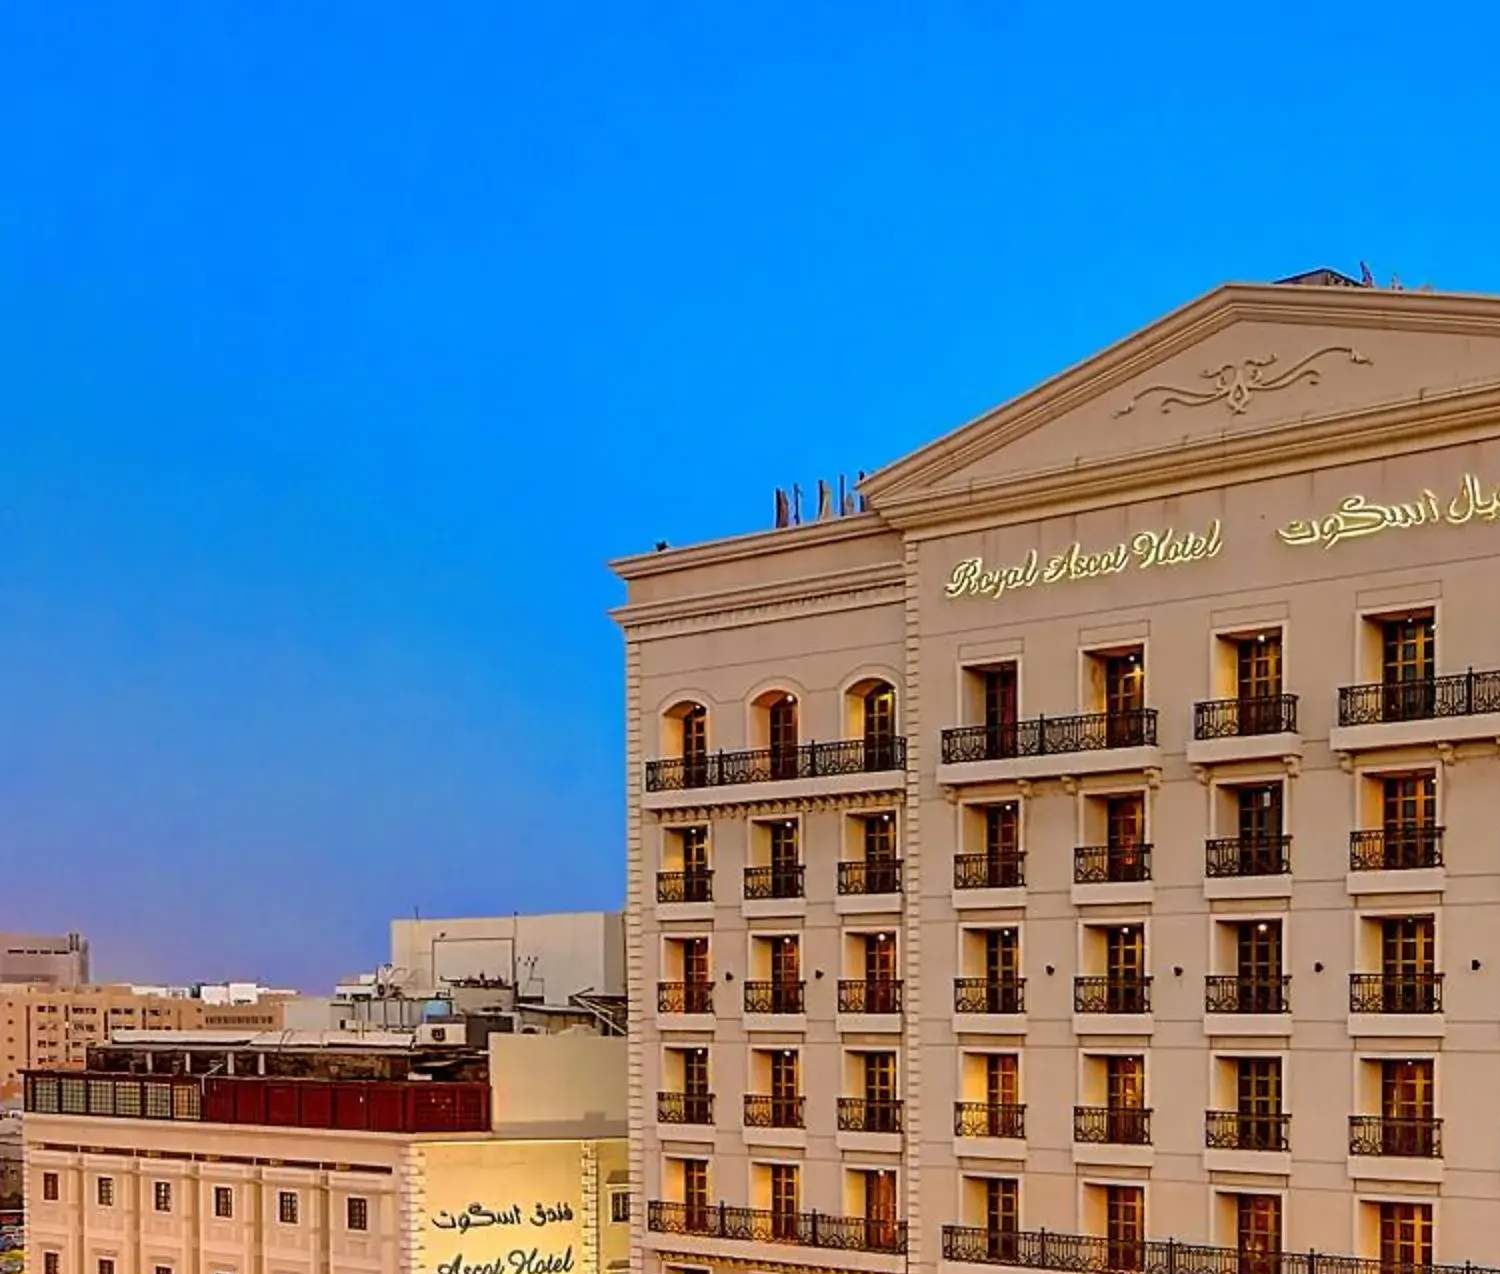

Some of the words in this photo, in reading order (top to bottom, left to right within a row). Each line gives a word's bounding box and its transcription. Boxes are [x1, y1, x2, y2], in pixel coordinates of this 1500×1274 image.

[944, 548, 1039, 598] Royal
[1043, 541, 1129, 583] Ascot
[1132, 518, 1223, 569] Hotel
[530, 1201, 573, 1227] فندق
